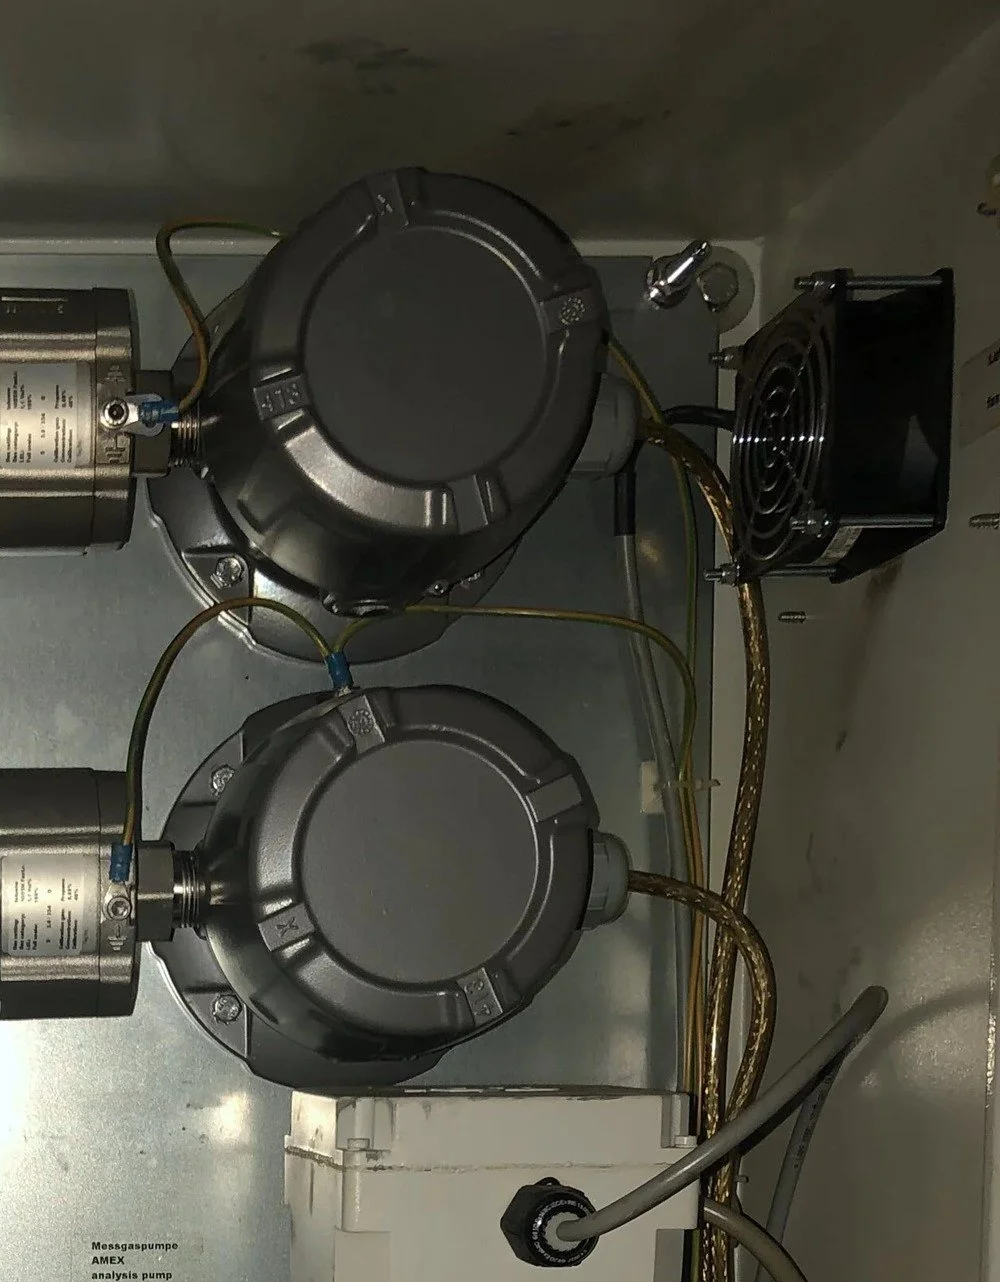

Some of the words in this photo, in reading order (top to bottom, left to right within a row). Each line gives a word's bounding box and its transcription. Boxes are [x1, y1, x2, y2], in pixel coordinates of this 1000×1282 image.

[91, 1241, 179, 1252] Messgaspumpe
[91, 1256, 125, 1265] AMEX
[91, 1270, 138, 1281] analysis
[142, 1272, 173, 1281] pump
